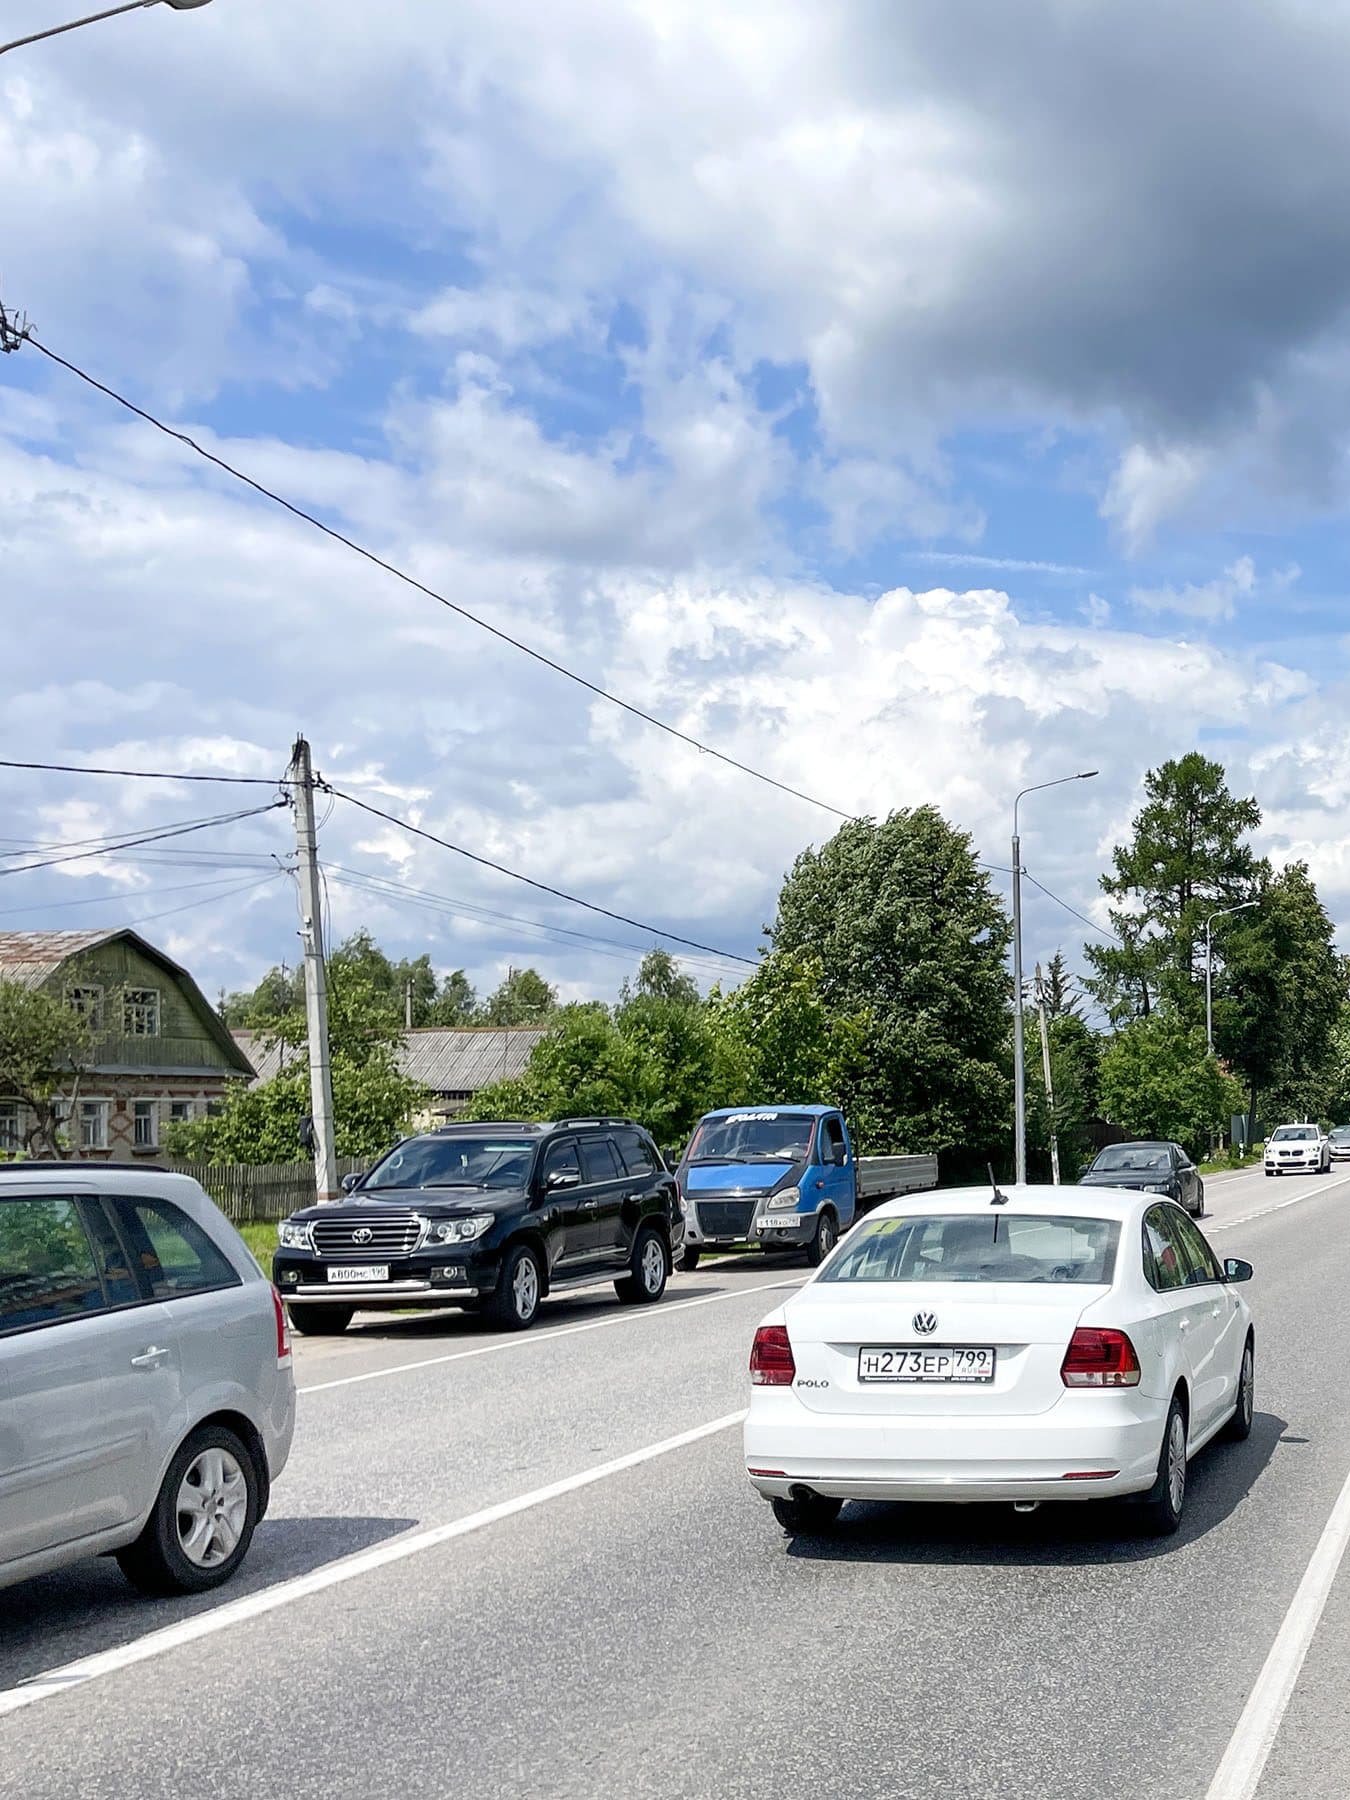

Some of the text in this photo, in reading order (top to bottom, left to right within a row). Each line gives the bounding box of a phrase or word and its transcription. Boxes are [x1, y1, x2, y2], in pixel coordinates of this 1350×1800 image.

[866, 1350, 987, 1373] Н273ЕР 799
[797, 1380, 830, 1389] POLO
